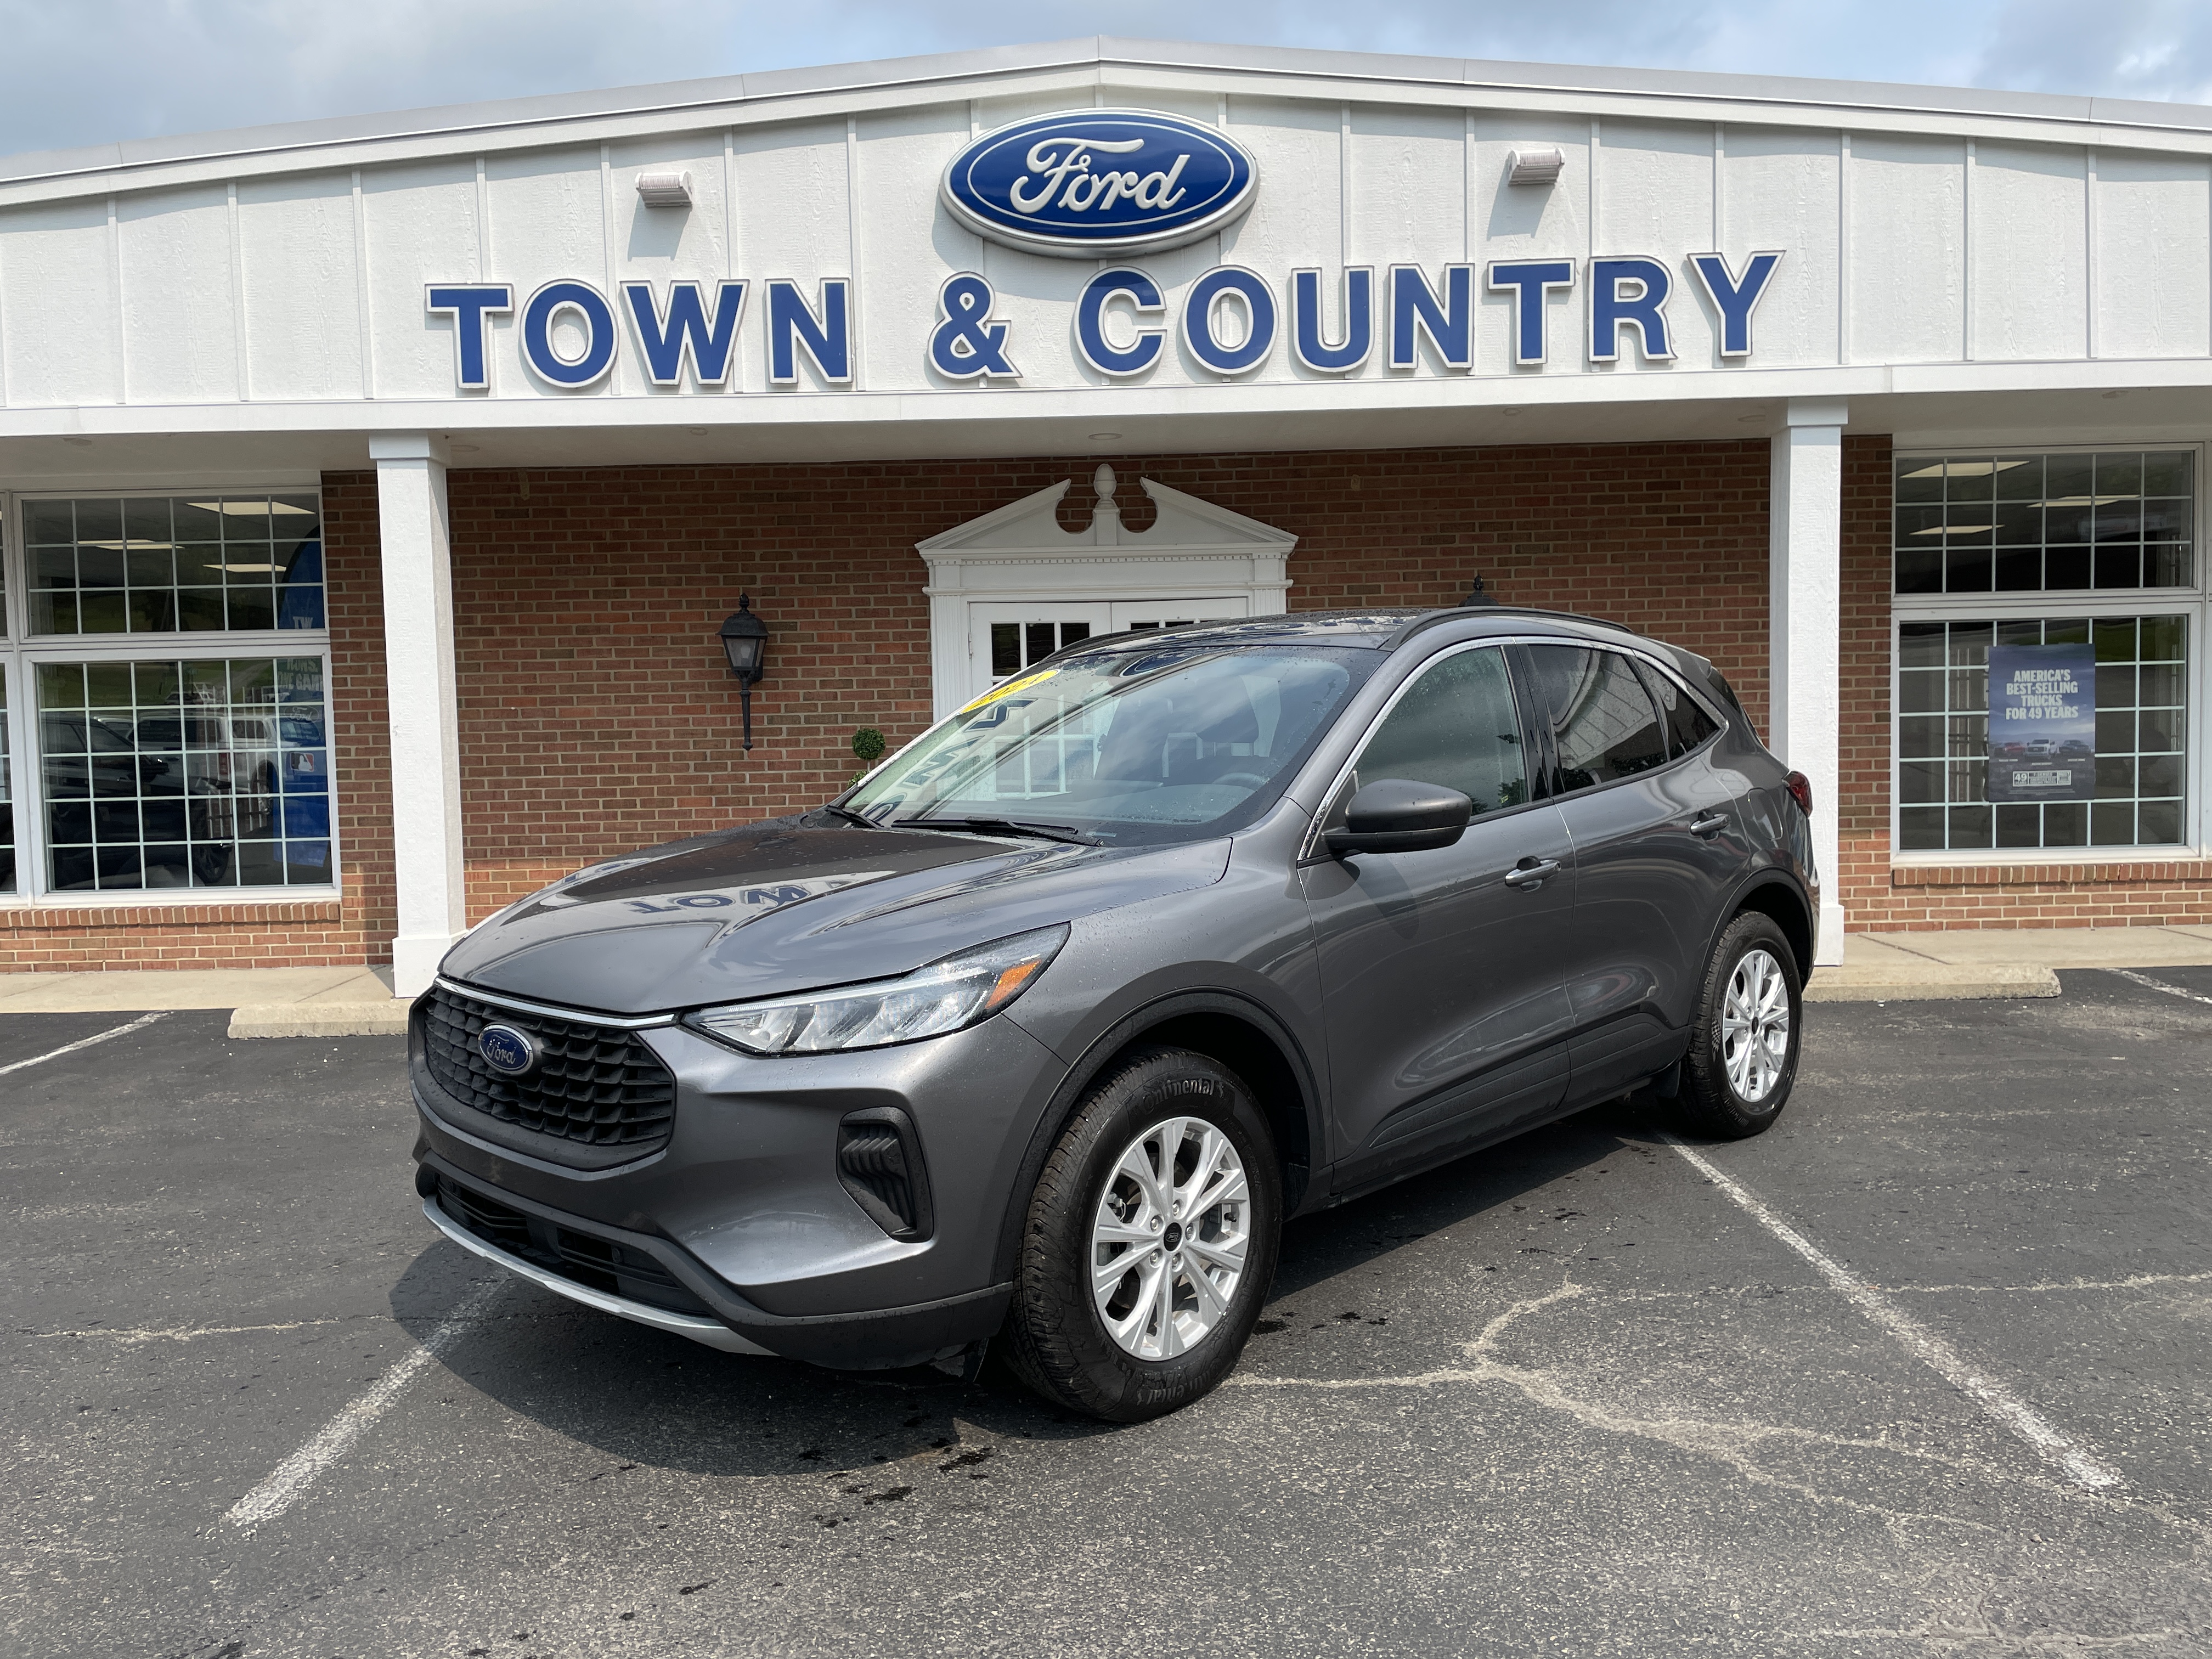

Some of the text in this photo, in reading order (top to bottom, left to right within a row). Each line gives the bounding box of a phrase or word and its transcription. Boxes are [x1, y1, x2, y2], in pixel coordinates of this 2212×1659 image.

[1009, 137, 1190, 214] Ford
[424, 250, 1787, 390] TOWN & COUNTRY
[2013, 669, 2071, 682] AMERICA'S
[2006, 681, 2079, 695] BEST-SELLING
[2021, 695, 2063, 707] TRUCKS
[2006, 706, 2079, 720] FOR 49 YEARS
[2015, 772, 2027, 781] 49
[486, 1034, 517, 1064] Ford
